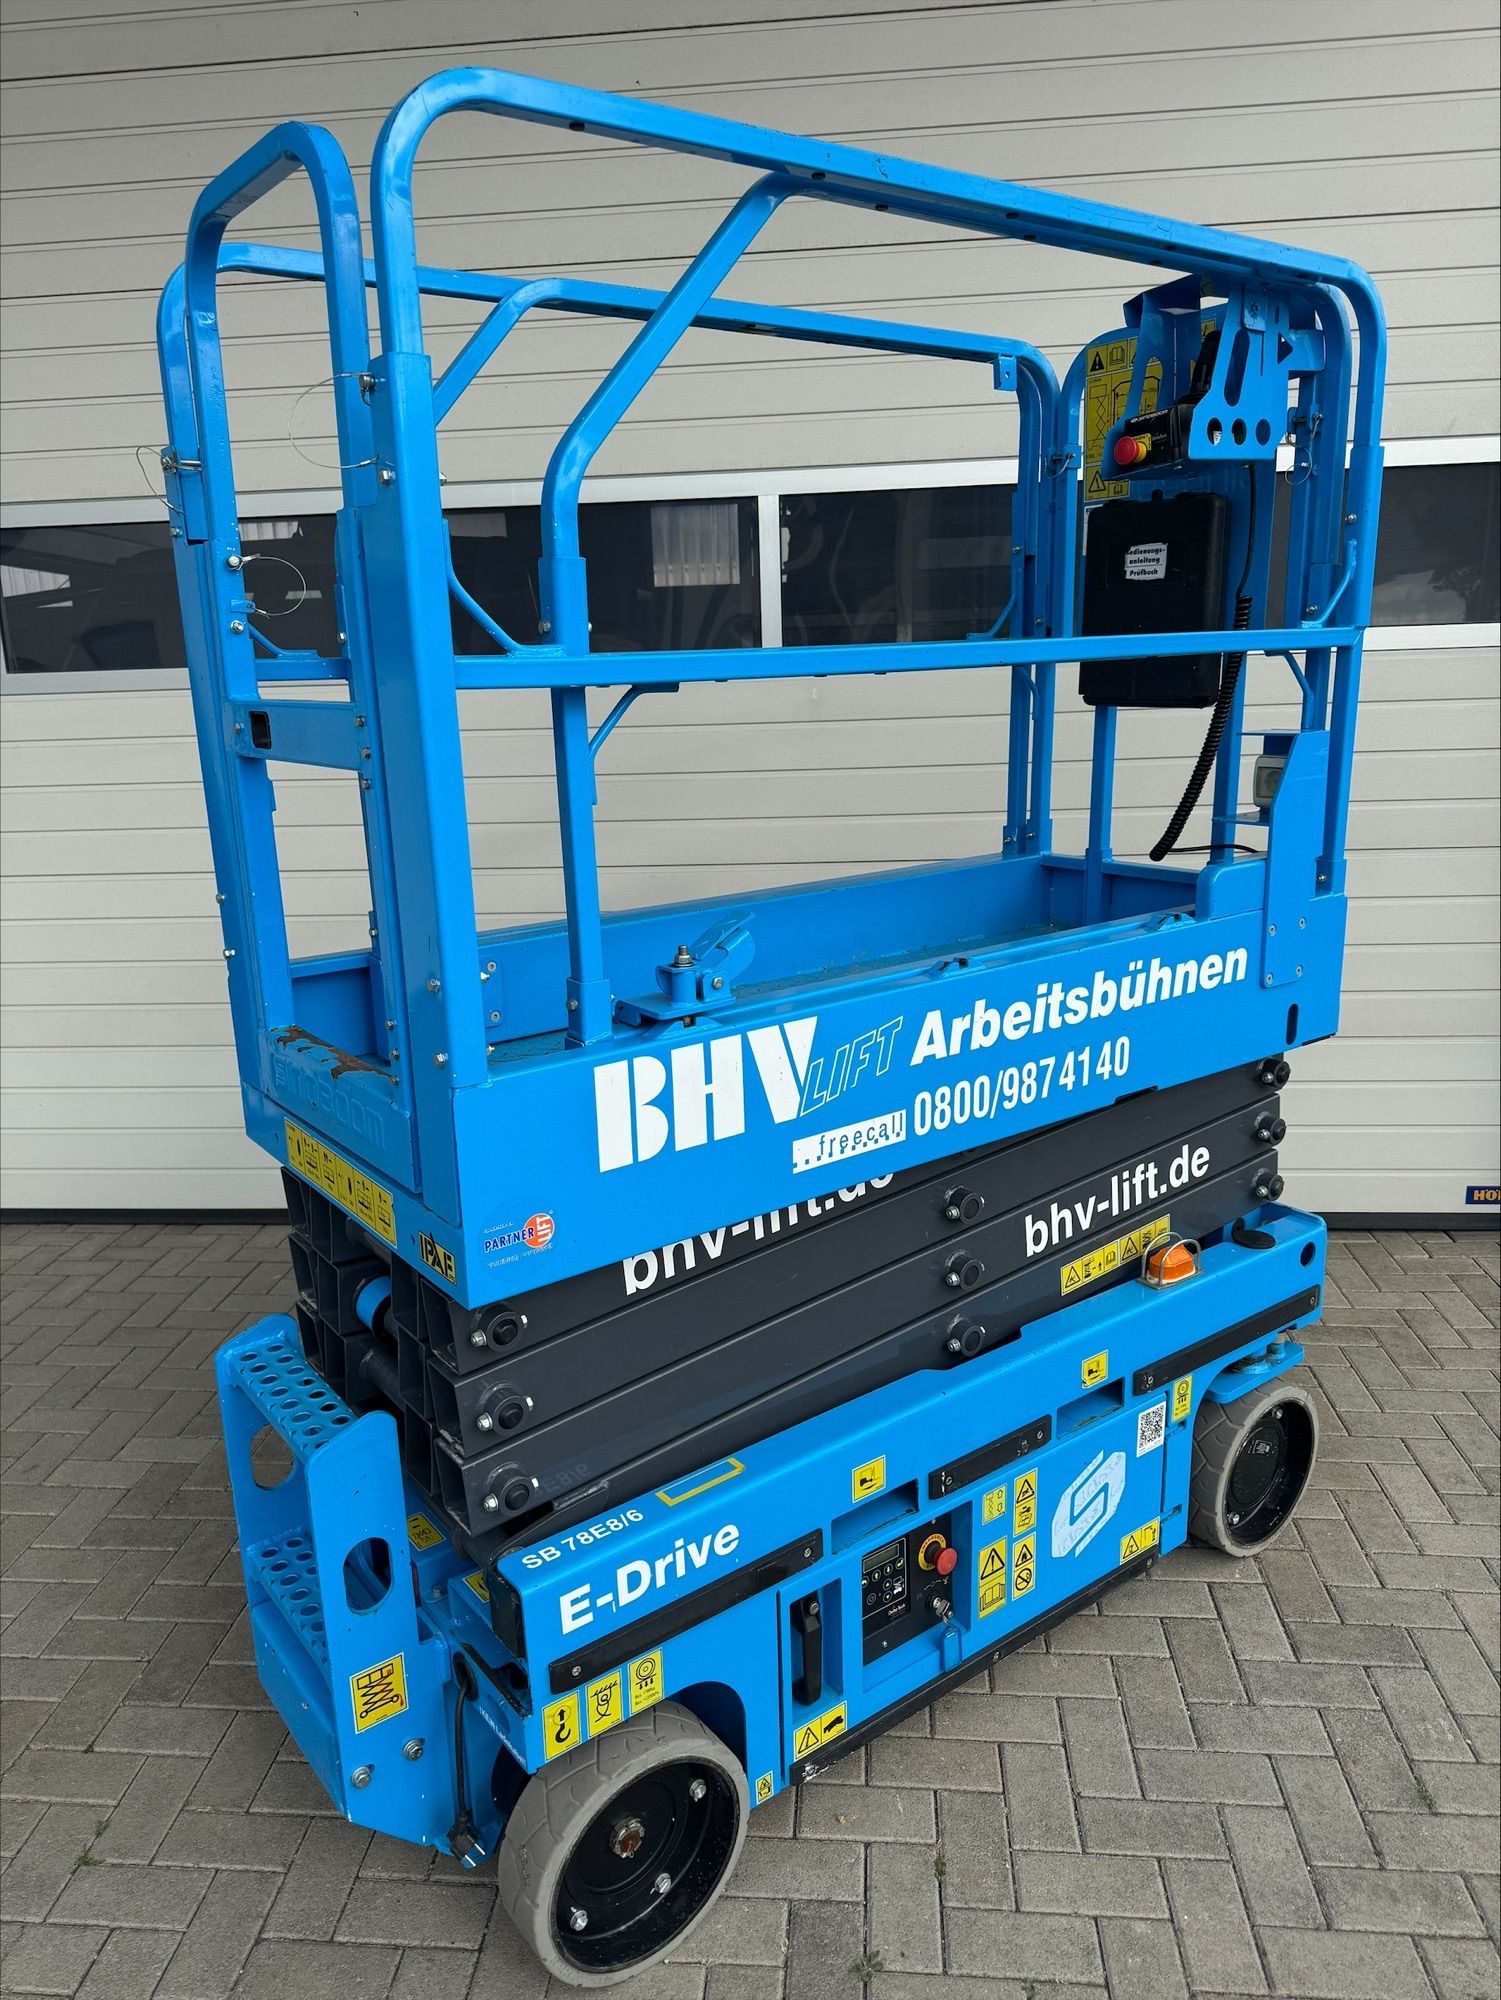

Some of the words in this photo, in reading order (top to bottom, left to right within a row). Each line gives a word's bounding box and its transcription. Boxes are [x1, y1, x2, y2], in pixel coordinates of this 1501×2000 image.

[594, 1016, 818, 1173] BHV
[800, 1016, 904, 1117] LIFT
[910, 947, 1248, 1066] Arbeitsbühnen
[914, 1035, 1131, 1136] 0800/9874140
[484, 1227, 534, 1253] PARTNER
[1025, 1143, 1210, 1257] bhv-lift.de
[521, 1546, 562, 1570] SB
[560, 1509, 644, 1551] 78E8/6
[559, 1524, 740, 1635] E-Drive
